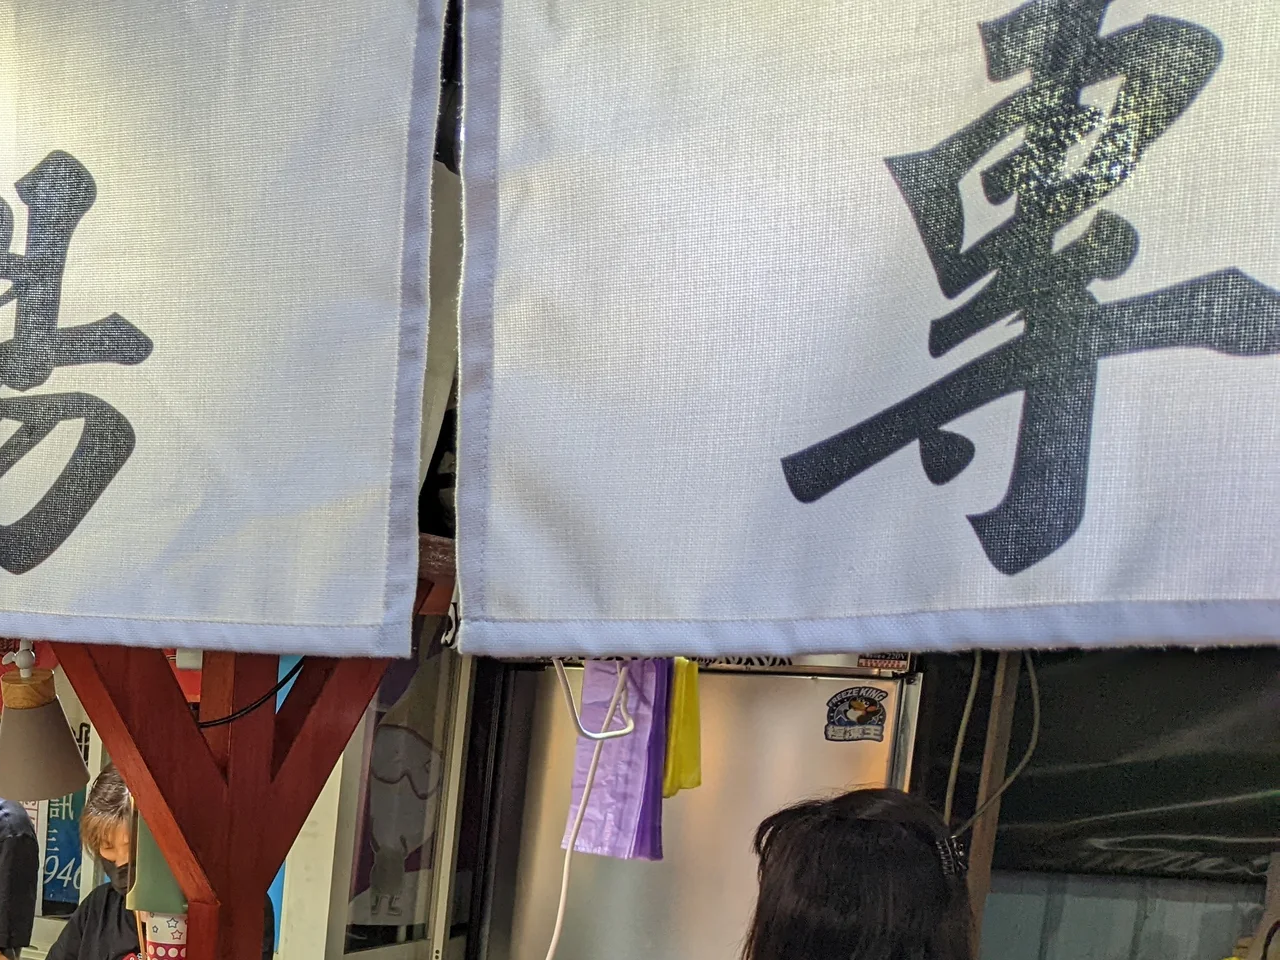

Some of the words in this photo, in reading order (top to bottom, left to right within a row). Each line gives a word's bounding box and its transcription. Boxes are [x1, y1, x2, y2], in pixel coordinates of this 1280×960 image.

[780, 0, 1280, 576] 專
[828, 688, 860, 706] FREEZE
[860, 687, 887, 701] KING
